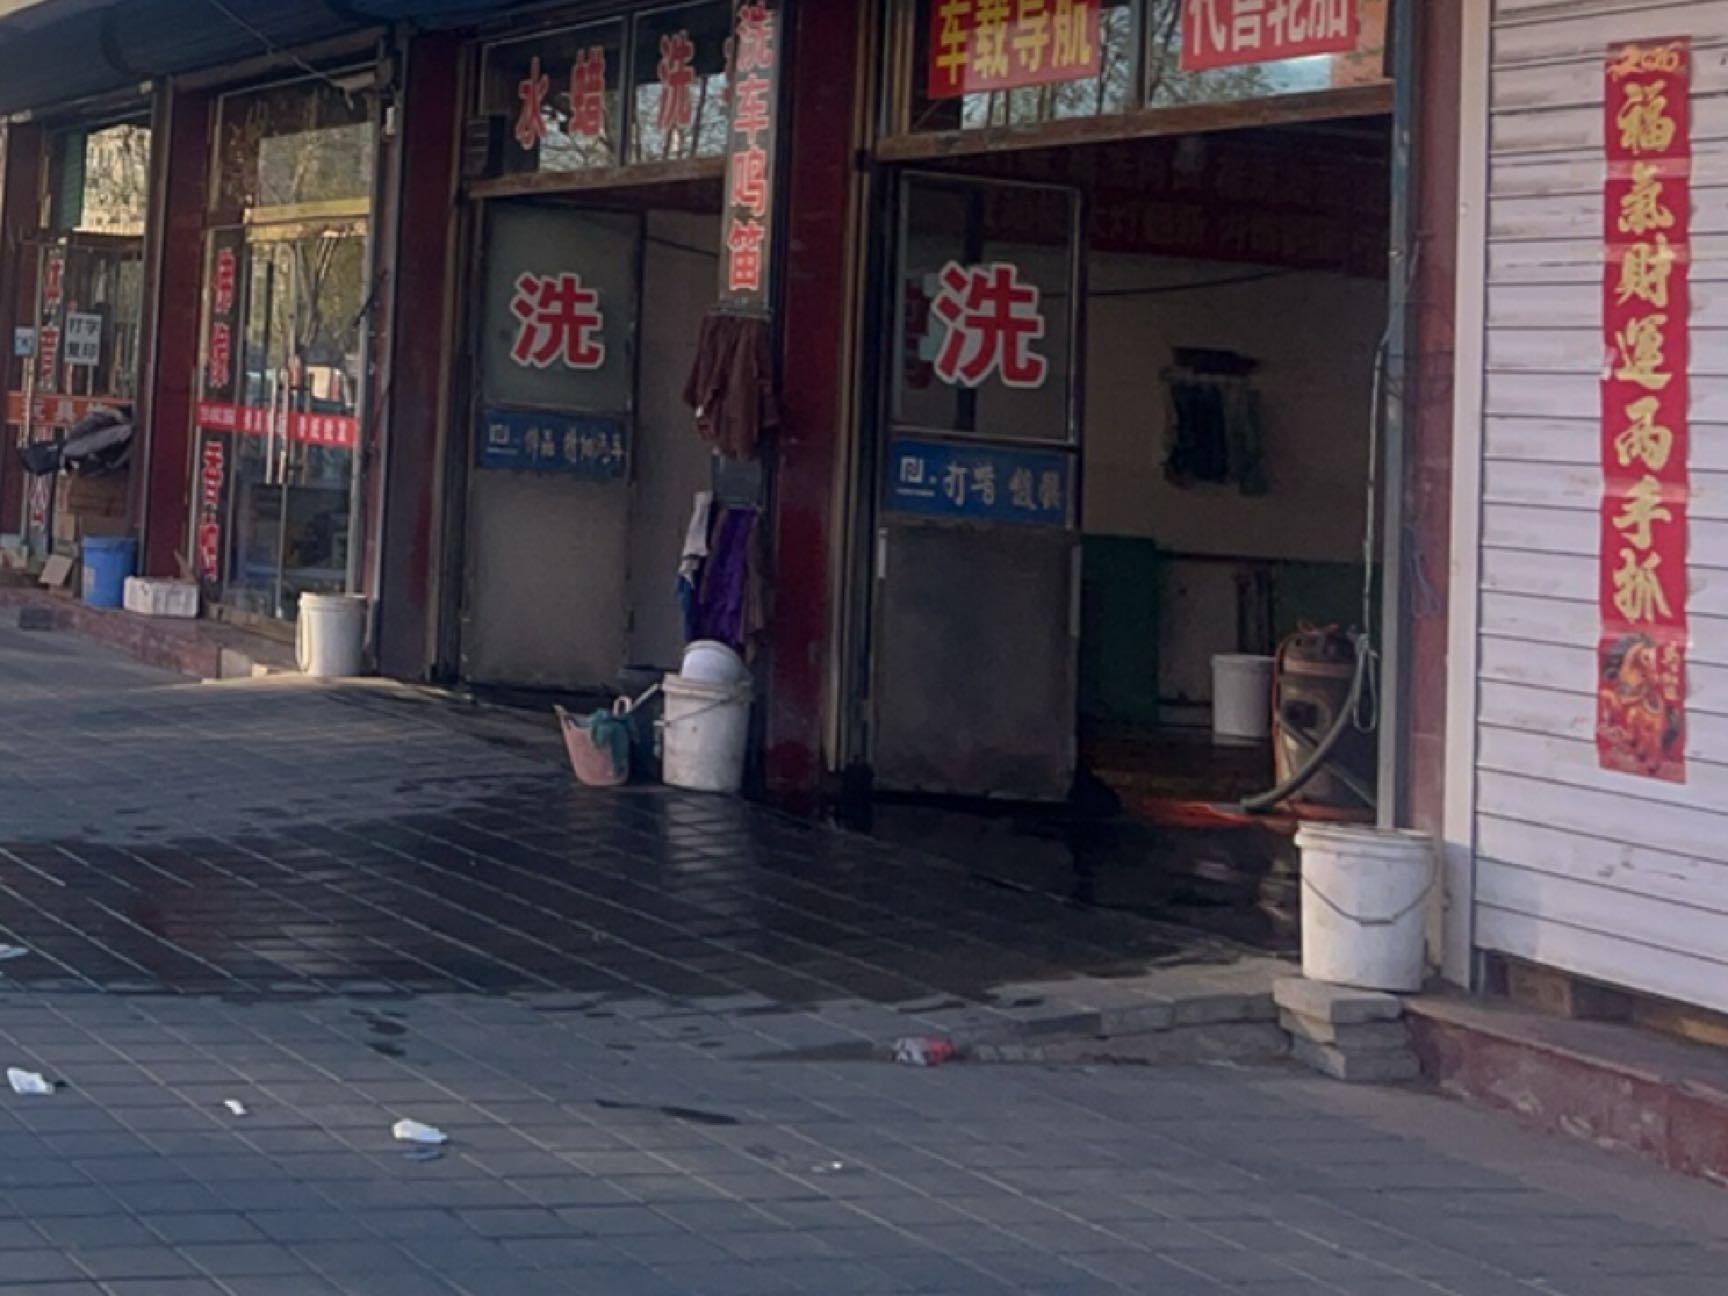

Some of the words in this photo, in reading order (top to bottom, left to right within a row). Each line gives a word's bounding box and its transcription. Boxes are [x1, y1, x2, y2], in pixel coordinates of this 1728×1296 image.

[726, 0, 775, 291] 洗车鸣笛
[510, 271, 606, 370] 洗
[933, 260, 1047, 389] 洗
